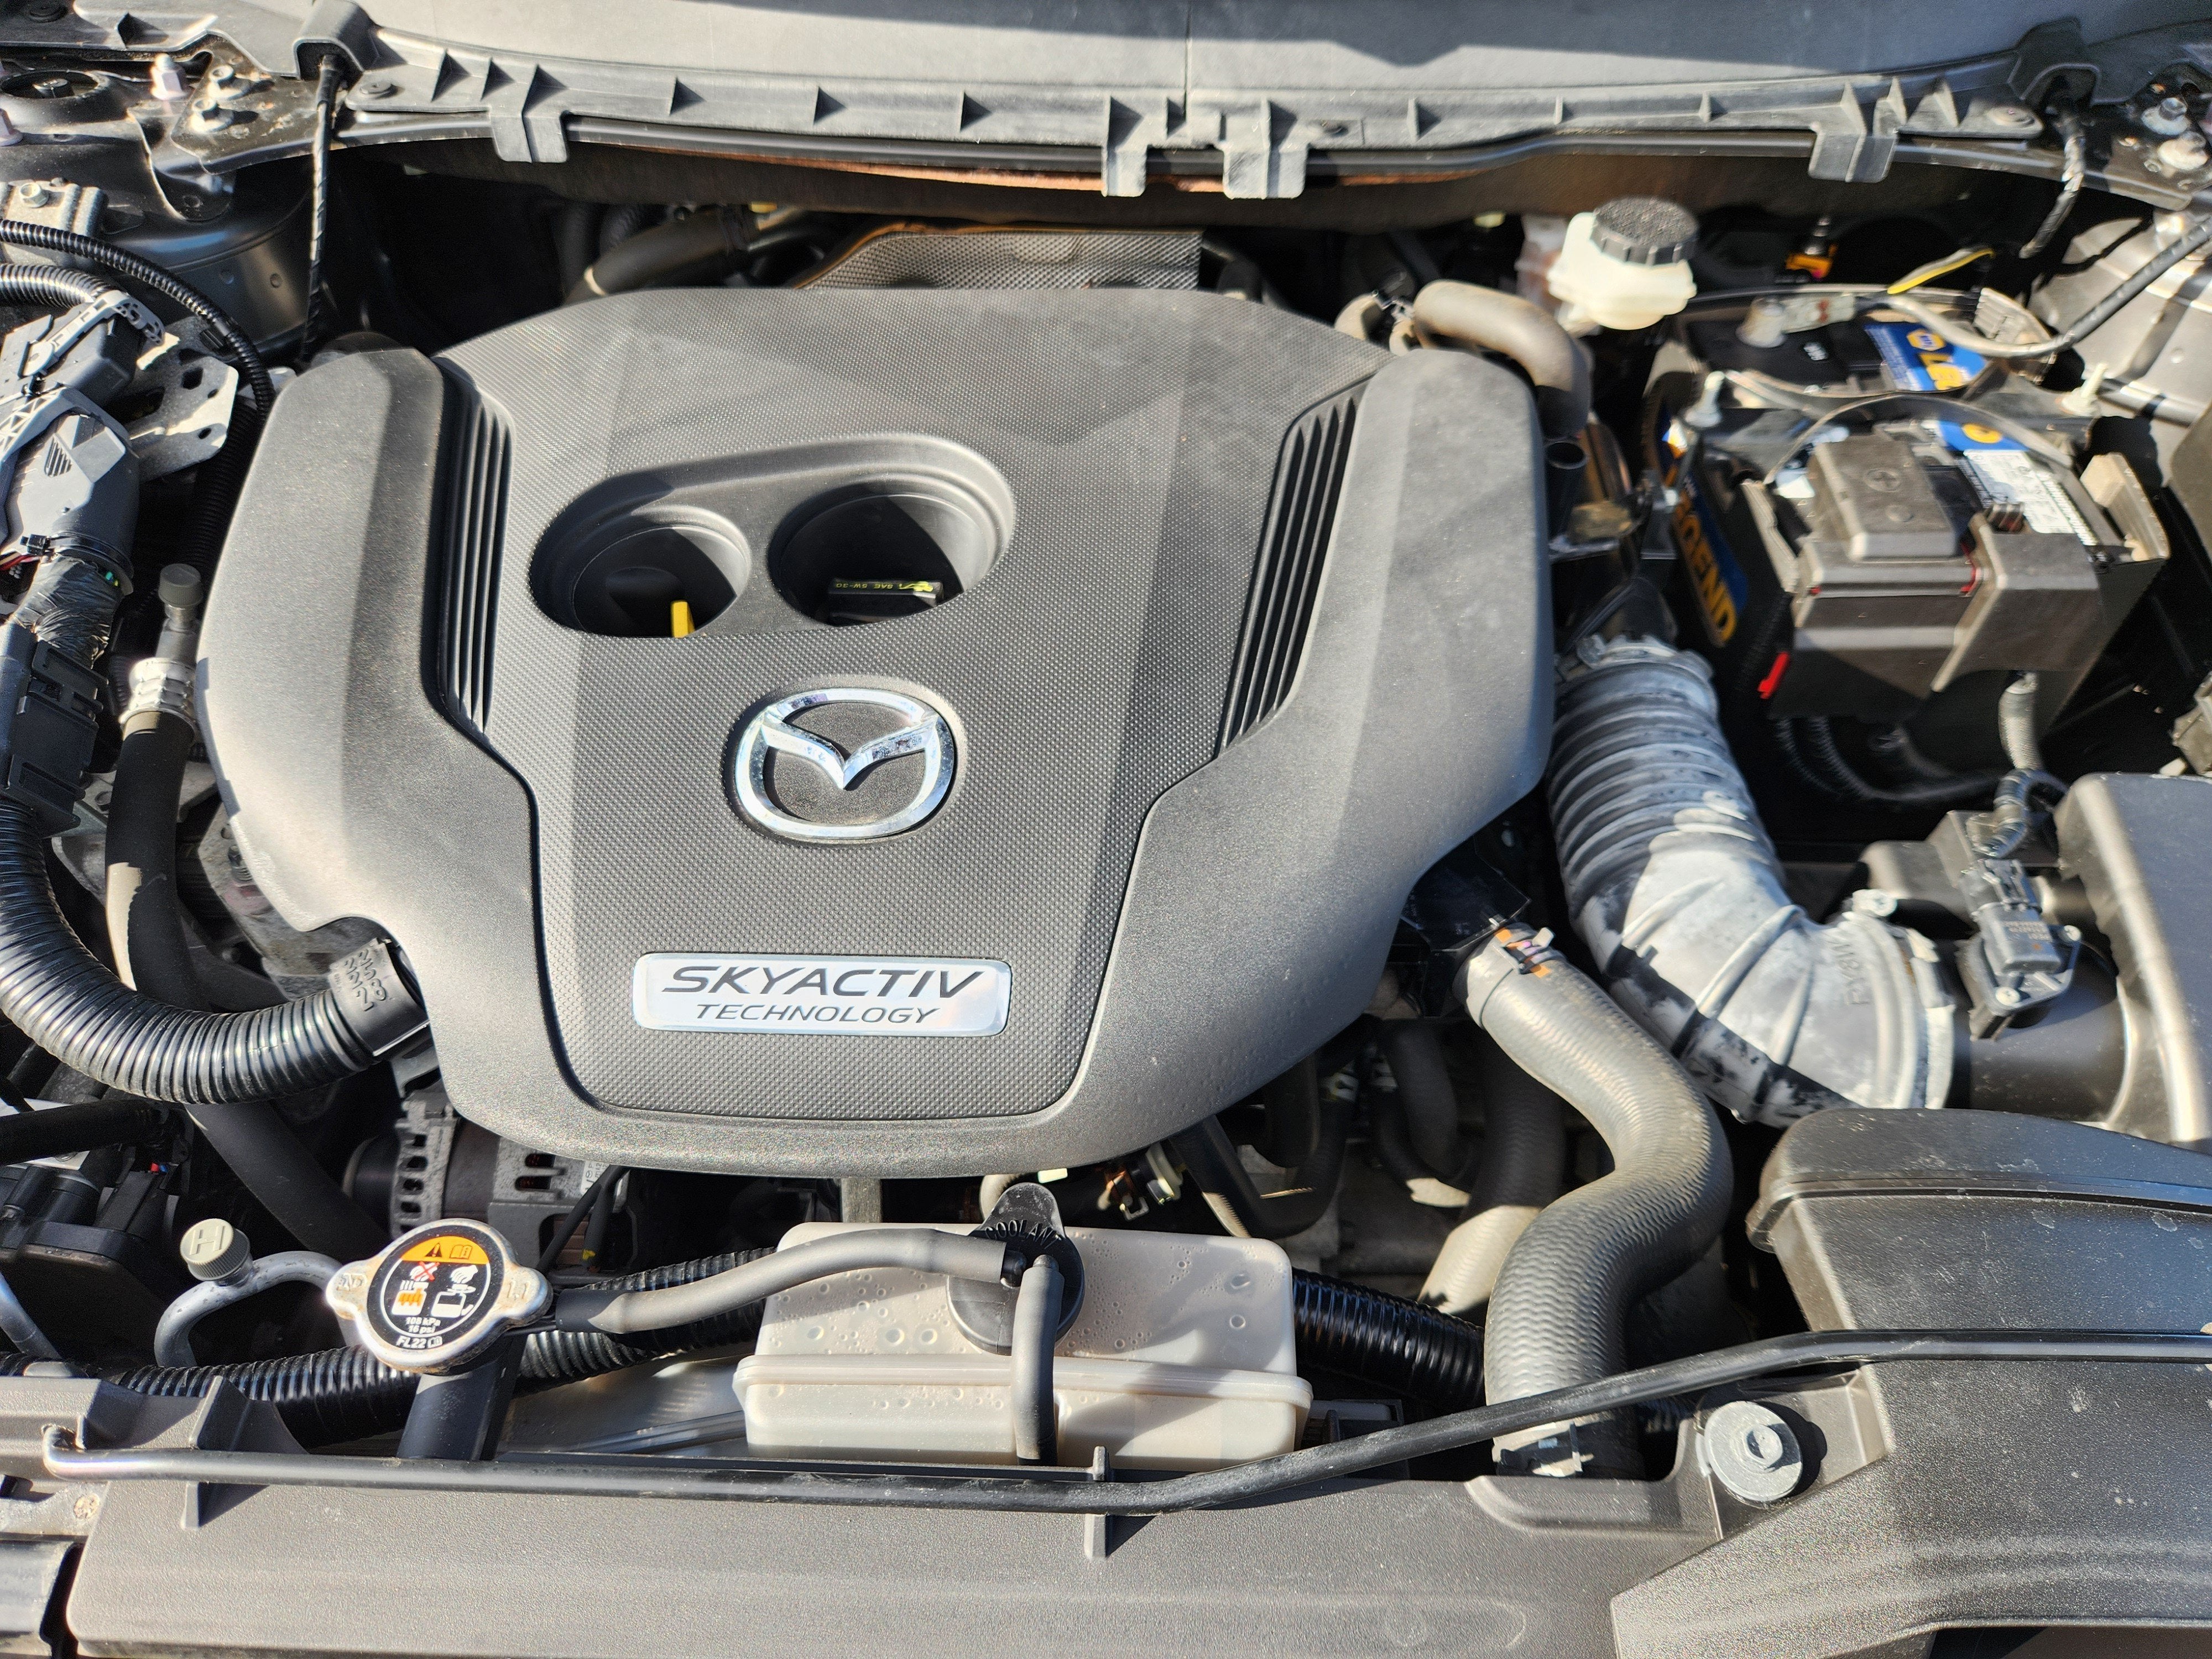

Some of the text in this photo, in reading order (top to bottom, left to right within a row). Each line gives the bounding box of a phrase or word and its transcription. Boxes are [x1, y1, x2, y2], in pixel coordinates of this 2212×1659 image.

[662, 965, 984, 999] SKYACTIV
[696, 1003, 940, 1024] TECHNOLOGY
[189, 1225, 226, 1255] H
[985, 1219, 1063, 1250] COOLANT
[405, 1316, 441, 1326] 108 kPa
[408, 1324, 435, 1334] 16 psi
[395, 1335, 427, 1349] FL22
